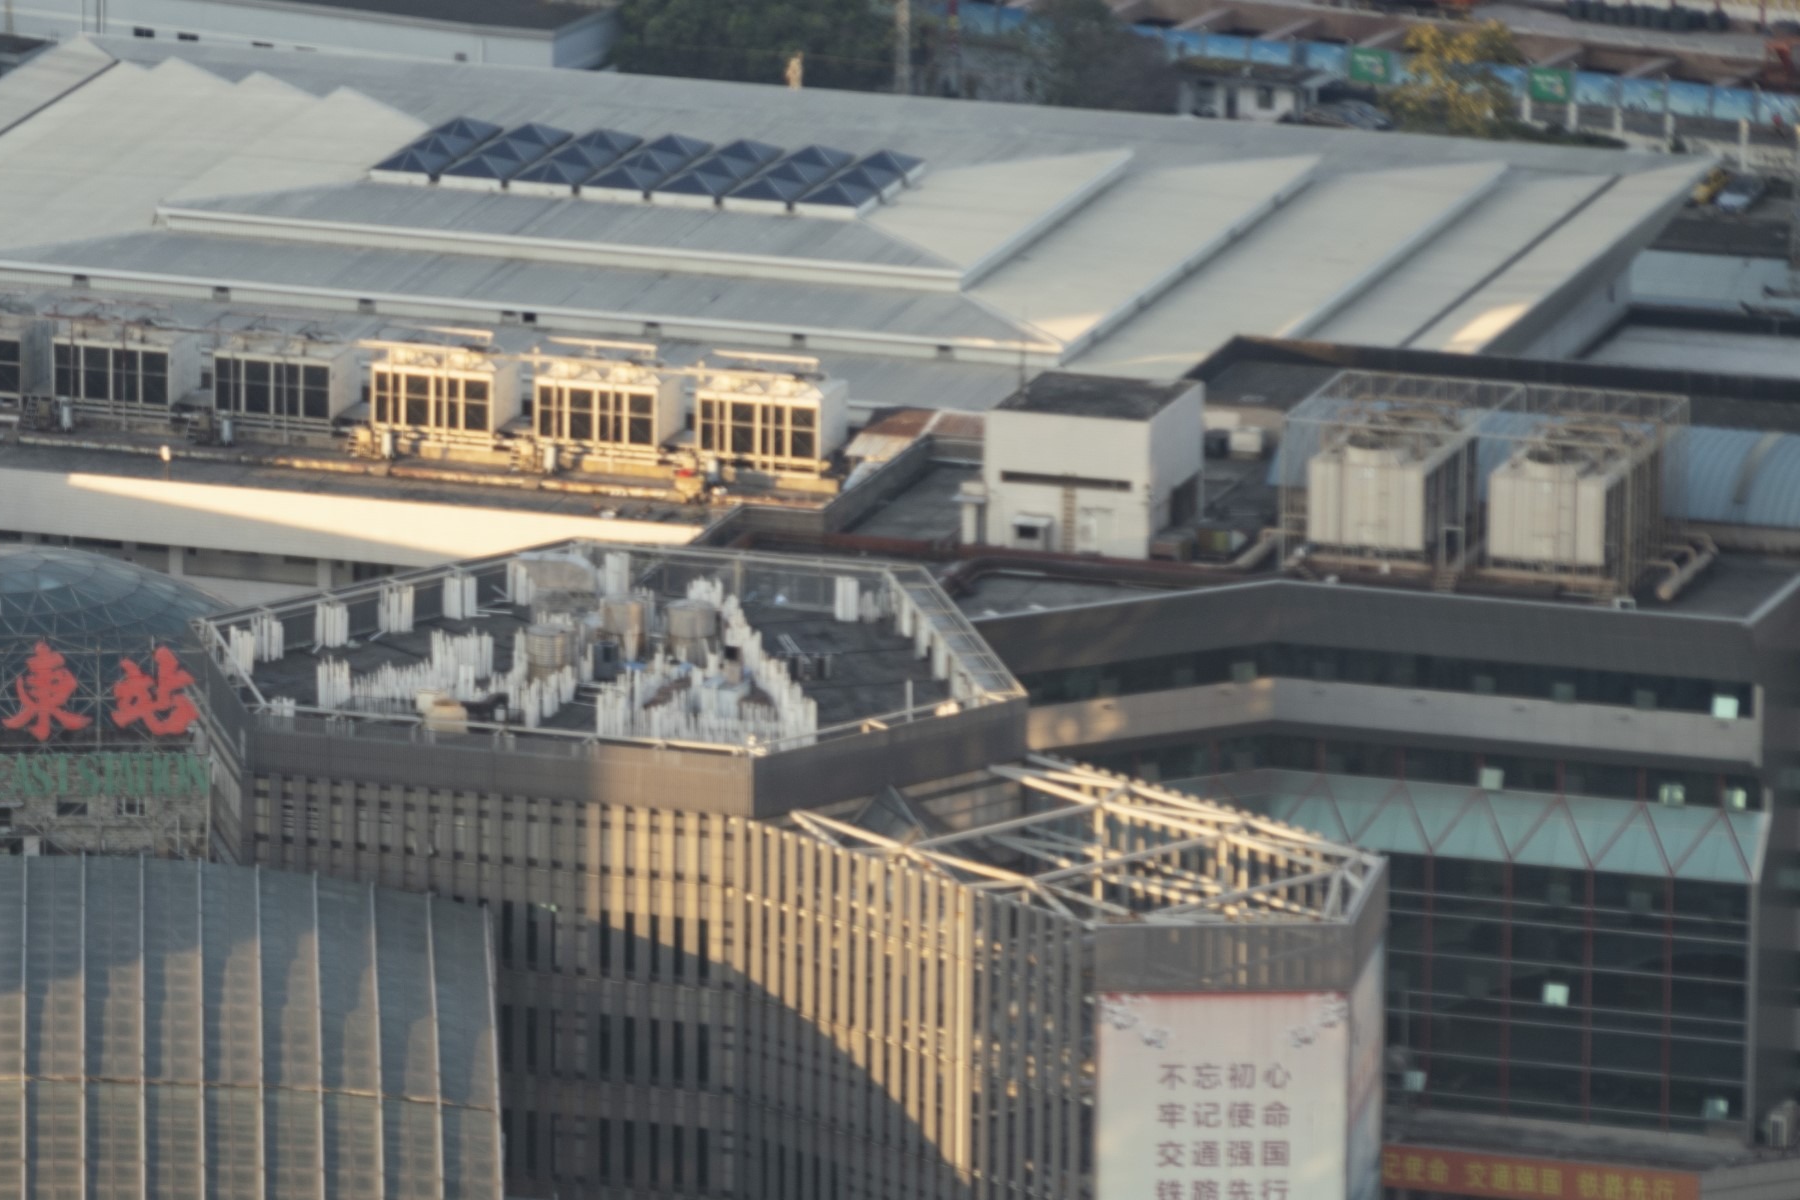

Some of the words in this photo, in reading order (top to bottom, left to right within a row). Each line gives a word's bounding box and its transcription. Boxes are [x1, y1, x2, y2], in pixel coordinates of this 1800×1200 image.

[75, 752, 209, 797] STATION
[1157, 1063, 1292, 1090] 不忘初心
[1156, 1102, 1291, 1129] 牢记使命
[1155, 1140, 1290, 1168] 交通强国
[1464, 1159, 1563, 1196] 交通强国
